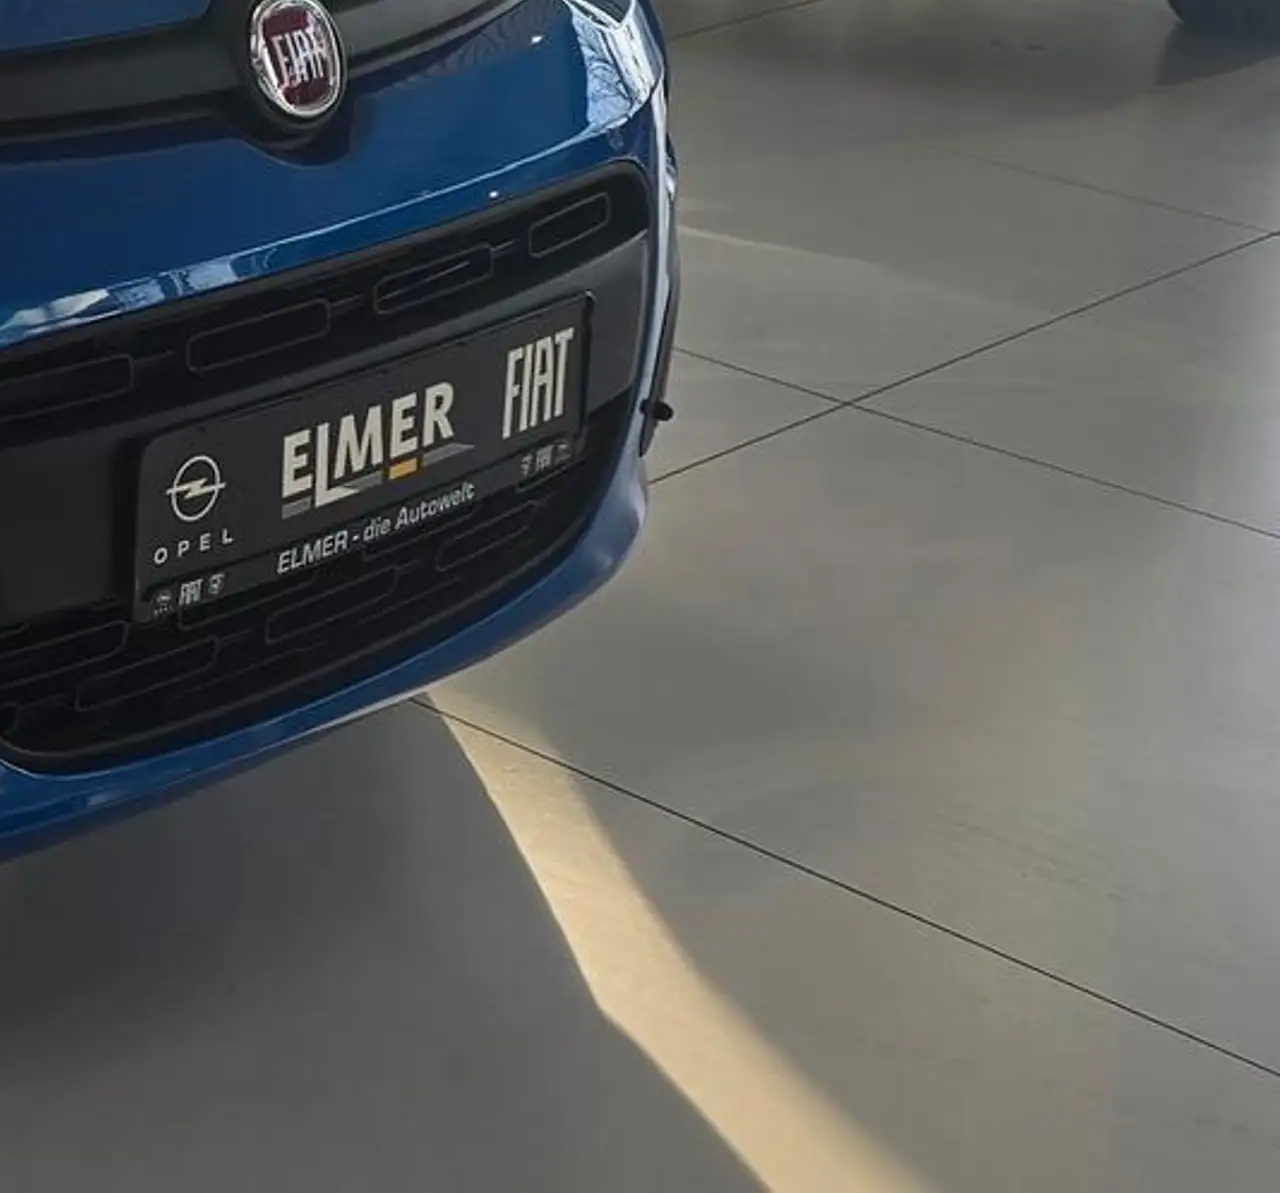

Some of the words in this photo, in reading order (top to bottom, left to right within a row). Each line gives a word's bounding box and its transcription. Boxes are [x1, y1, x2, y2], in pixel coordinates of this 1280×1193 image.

[271, 26, 327, 88] FIAT
[501, 326, 576, 440] FIAT
[281, 381, 454, 508] ELMER
[153, 527, 234, 565] OPEL
[276, 529, 348, 575] ELMER
[362, 516, 391, 542] die
[394, 481, 476, 531] Autowelt
